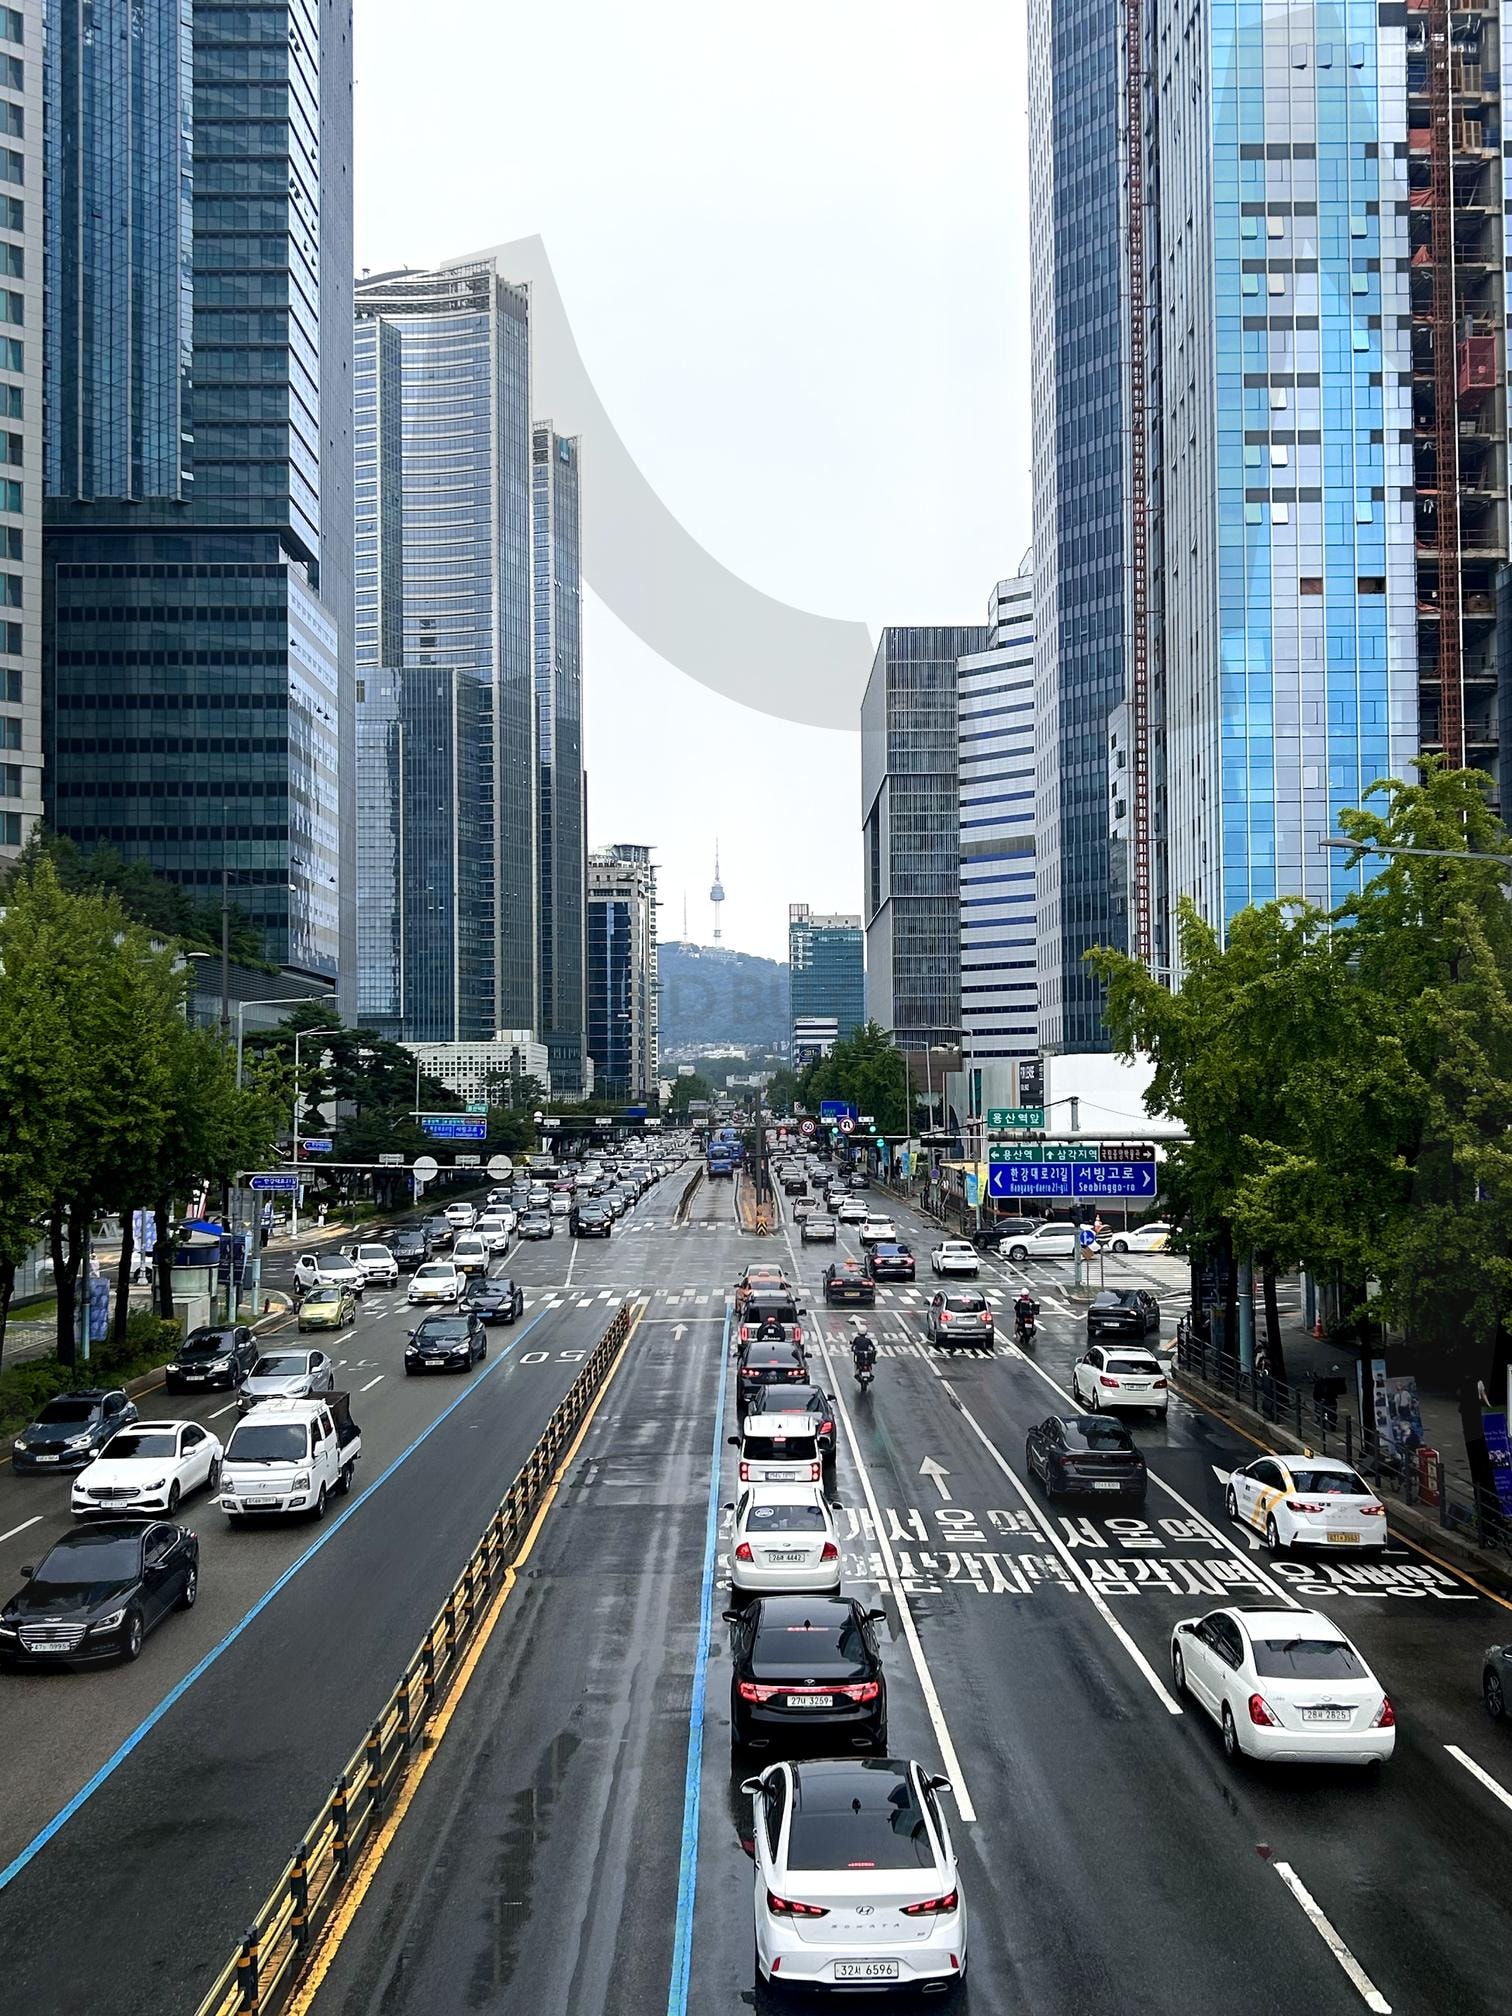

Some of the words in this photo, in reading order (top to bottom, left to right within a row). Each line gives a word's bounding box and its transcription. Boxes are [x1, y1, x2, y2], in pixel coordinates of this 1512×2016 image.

[992, 1112, 1040, 1124] 용산역앞
[804, 1123, 813, 1132] 50
[1003, 1149, 1033, 1160] 용산역
[1058, 1149, 1098, 1160] 삼각지역
[1079, 1167, 1135, 1181] 서빙고로
[1079, 1183, 1136, 1194] Seobinggo-ro
[519, 1350, 587, 1364] 50
[886, 1508, 1046, 1543] 서울역
[1057, 1517, 1225, 1550] 서울역
[899, 1552, 1080, 1593] 삼각지역
[1085, 1558, 1275, 1596] 삼각지역
[809, 1696, 829, 1705] 3259
[866, 1964, 893, 1976] 6596
